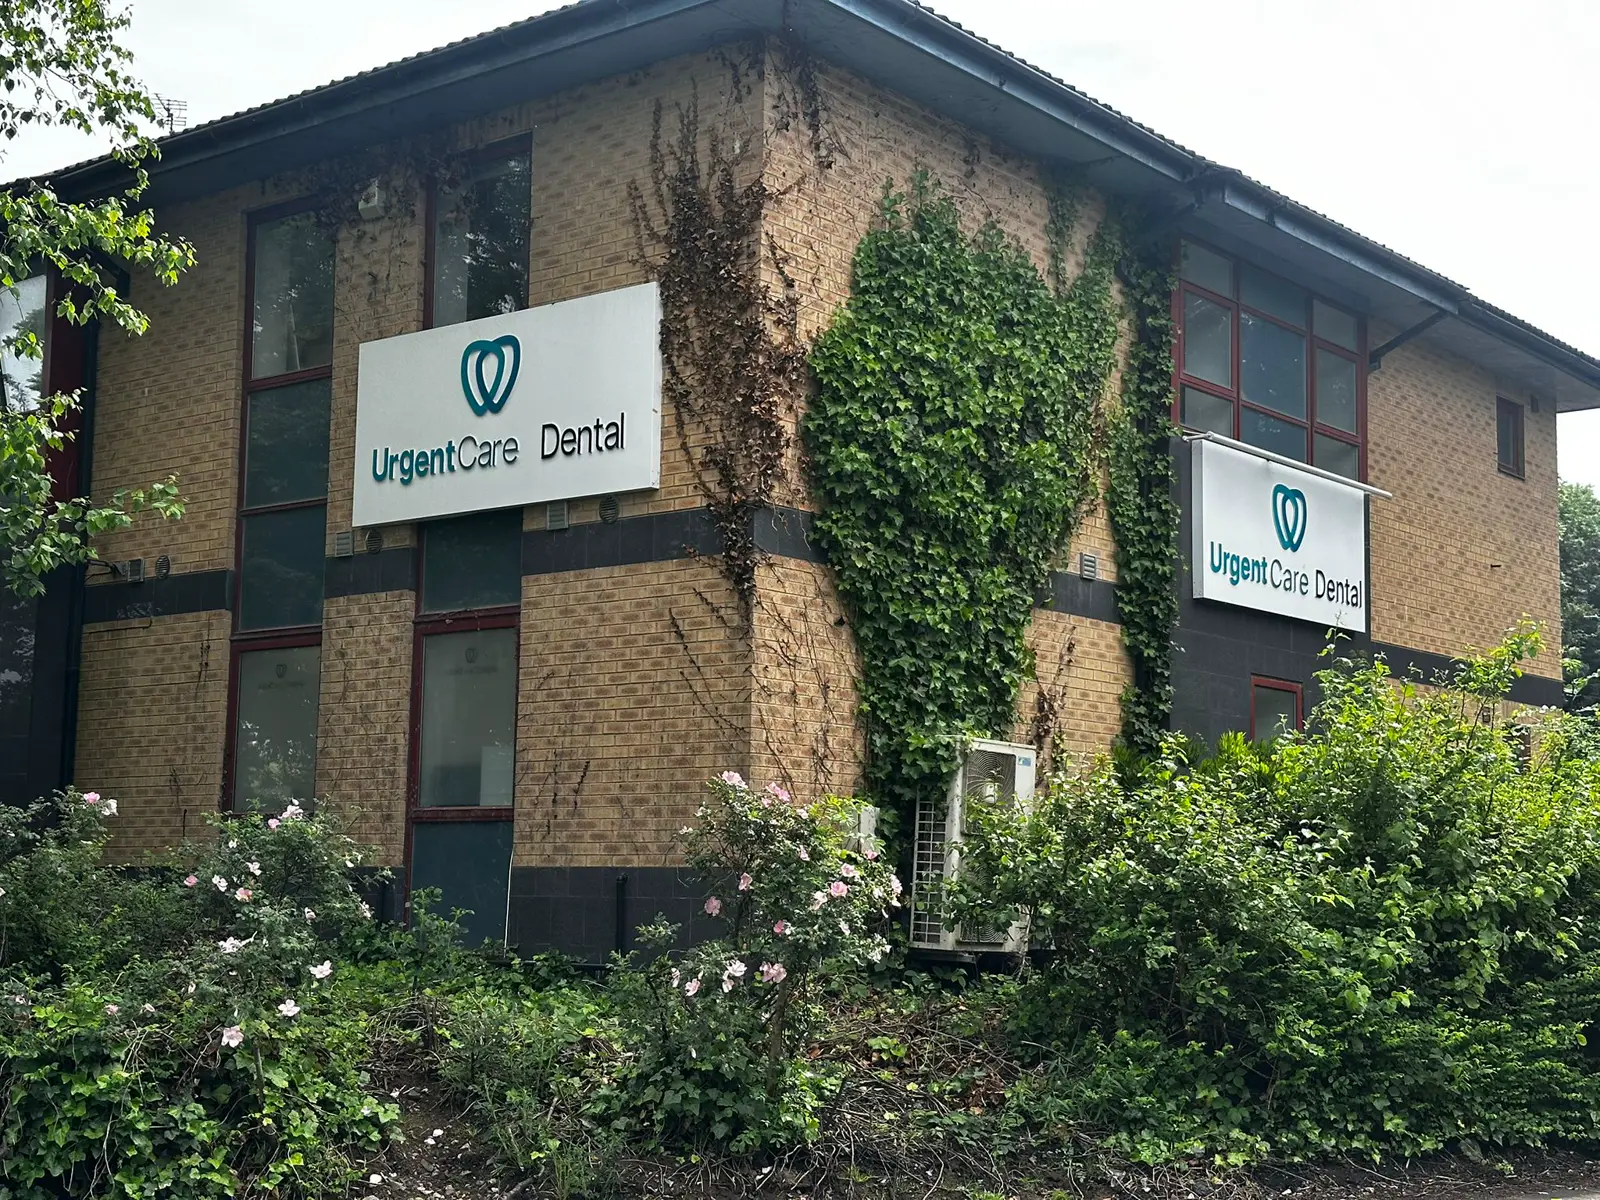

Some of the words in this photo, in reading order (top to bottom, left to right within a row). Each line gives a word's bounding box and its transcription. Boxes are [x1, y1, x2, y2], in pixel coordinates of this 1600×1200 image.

[372, 435, 519, 485] UrgentCare
[541, 412, 625, 460] Dental
[1315, 569, 1362, 609] Dental
